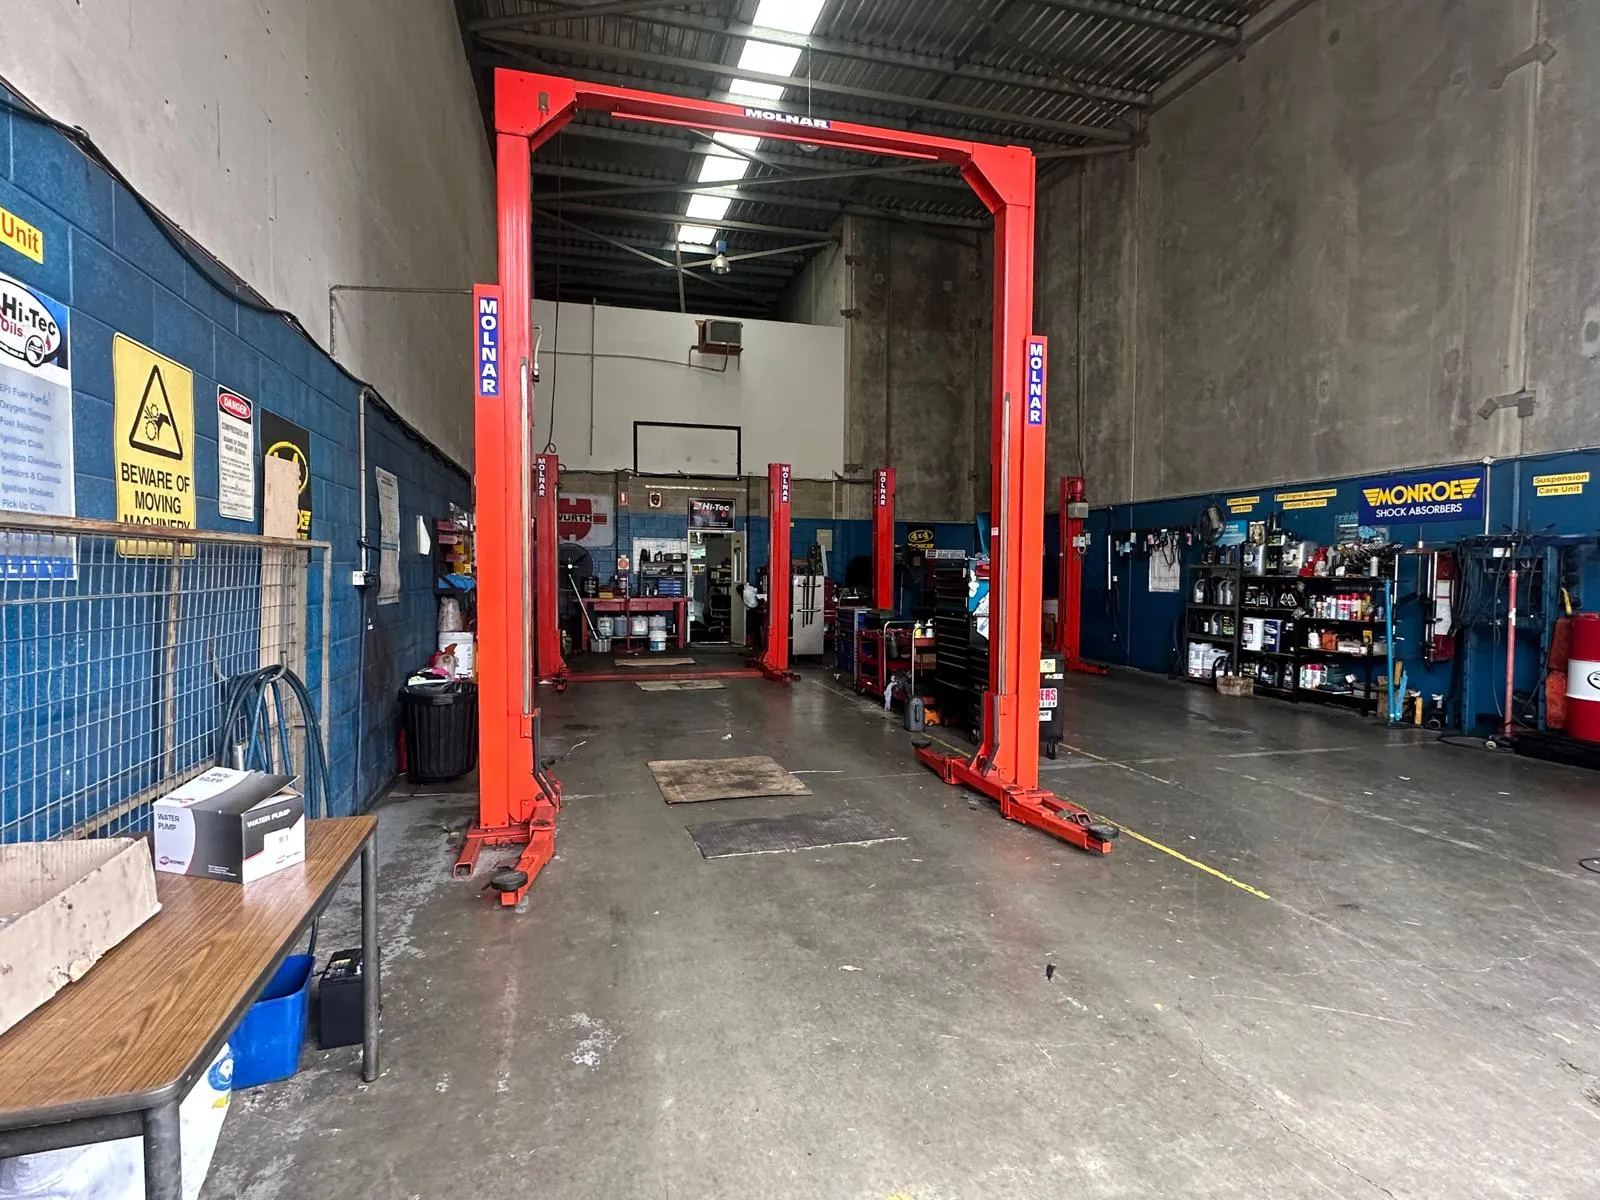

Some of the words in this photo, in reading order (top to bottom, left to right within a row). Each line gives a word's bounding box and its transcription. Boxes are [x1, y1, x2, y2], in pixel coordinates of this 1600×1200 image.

[745, 108, 829, 129] MOLNAR
[2, 212, 39, 254] Unit
[3, 292, 56, 336] Hi-Tec
[1, 320, 23, 338] Oils
[479, 298, 498, 394] MOLNAR
[1030, 343, 1044, 423] MOLNAR
[223, 396, 248, 417] DANGER
[121, 462, 173, 490] BEWARE
[176, 475, 190, 493] OF
[538, 458, 546, 496] MOLNAR
[1535, 474, 1587, 484] Suspension
[1375, 480, 1464, 507] MONROE
[1538, 487, 1559, 495] Care
[1561, 485, 1580, 493] Unit
[135, 490, 182, 514] MOVING
[702, 502, 730, 511] Hi-Tec
[1376, 507, 1407, 518] SHOCK
[1408, 503, 1463, 516] ABSORBERS
[0, 559, 60, 574] LITY
[157, 813, 180, 823] WATER
[158, 822, 177, 831] PUMP
[247, 814, 271, 828] WATER
[271, 808, 291, 820] PUMP
